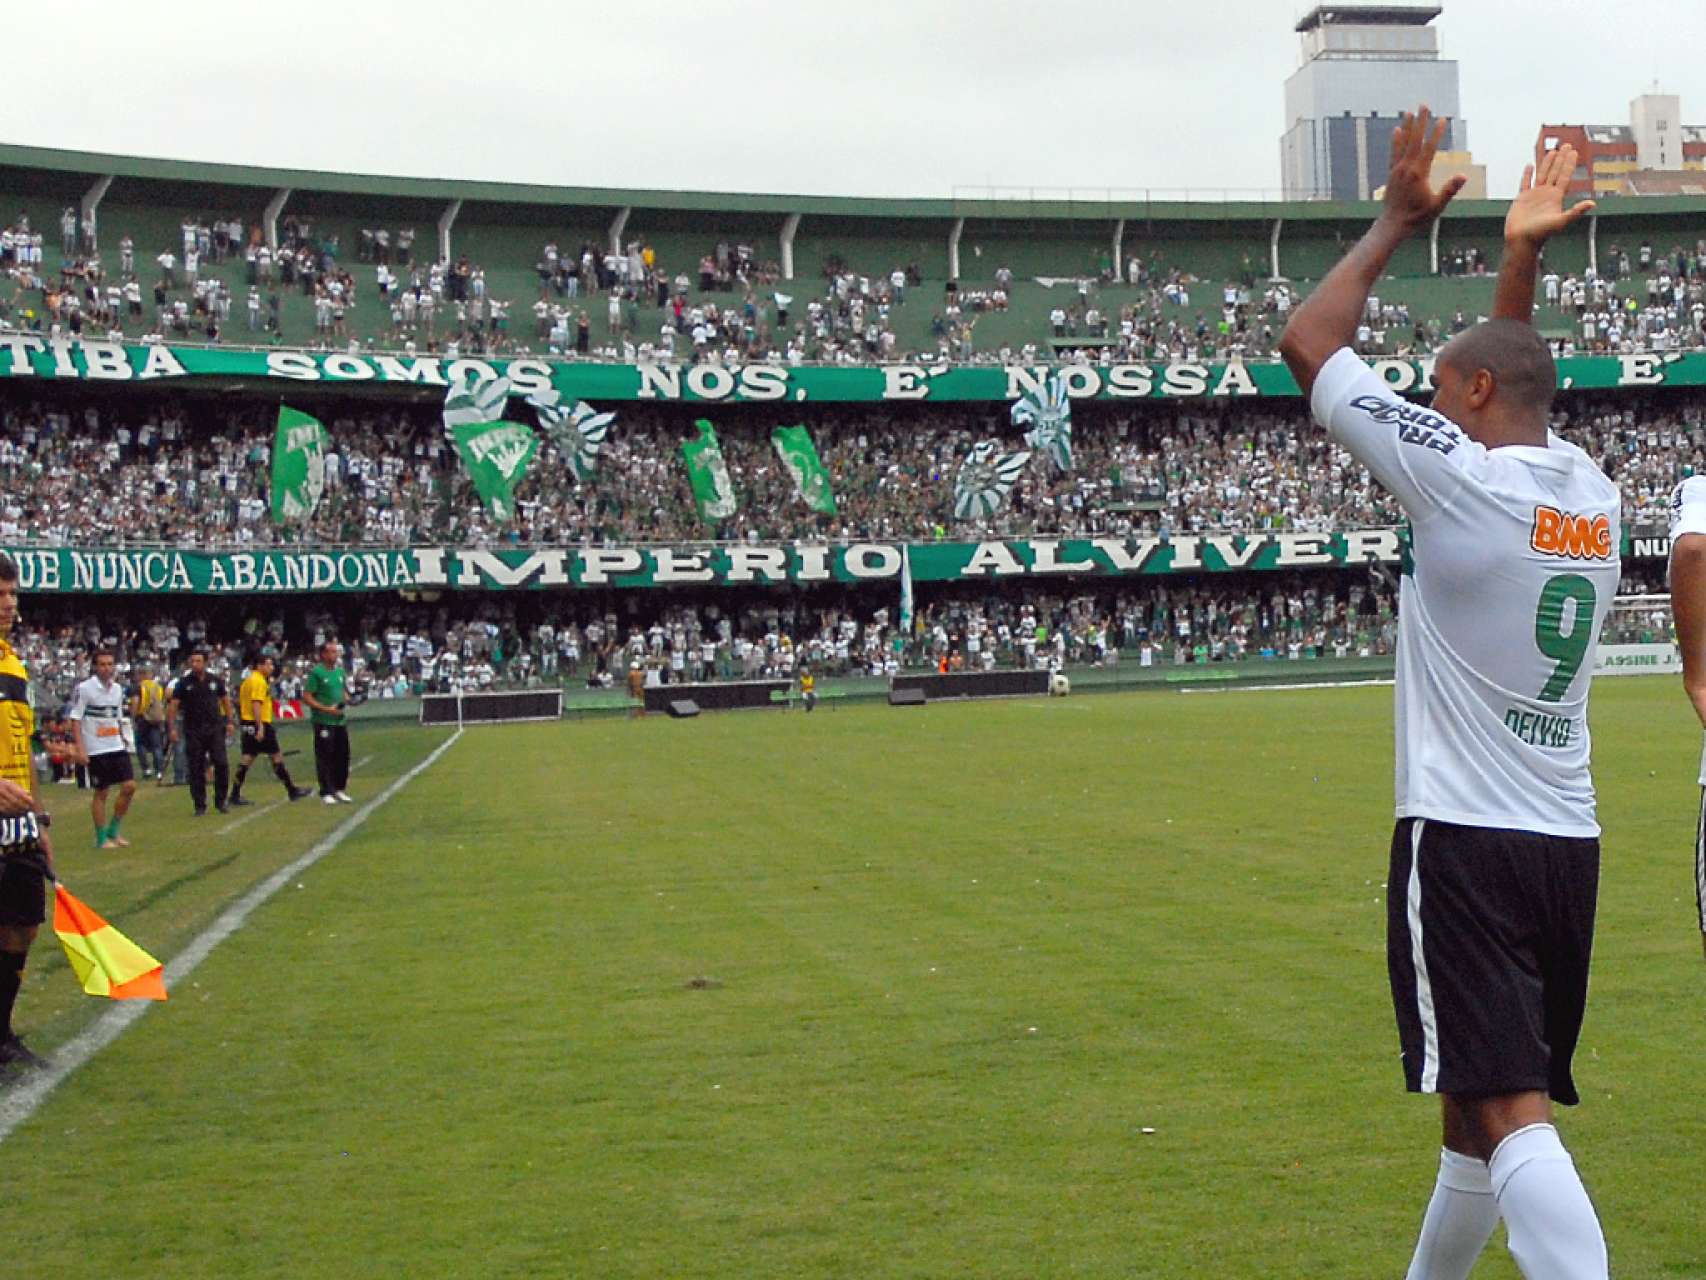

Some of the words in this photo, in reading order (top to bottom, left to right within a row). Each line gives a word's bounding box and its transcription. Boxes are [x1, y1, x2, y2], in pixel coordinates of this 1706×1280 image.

[266, 352, 554, 393] SOMOS
[1005, 363, 1258, 397] NOSSA
[1533, 506, 1613, 559] BMG
[71, 552, 193, 590] NUNCA
[208, 553, 413, 591] ABANDONA
[413, 544, 901, 586] IMPERIO
[1536, 573, 1596, 702] 9
